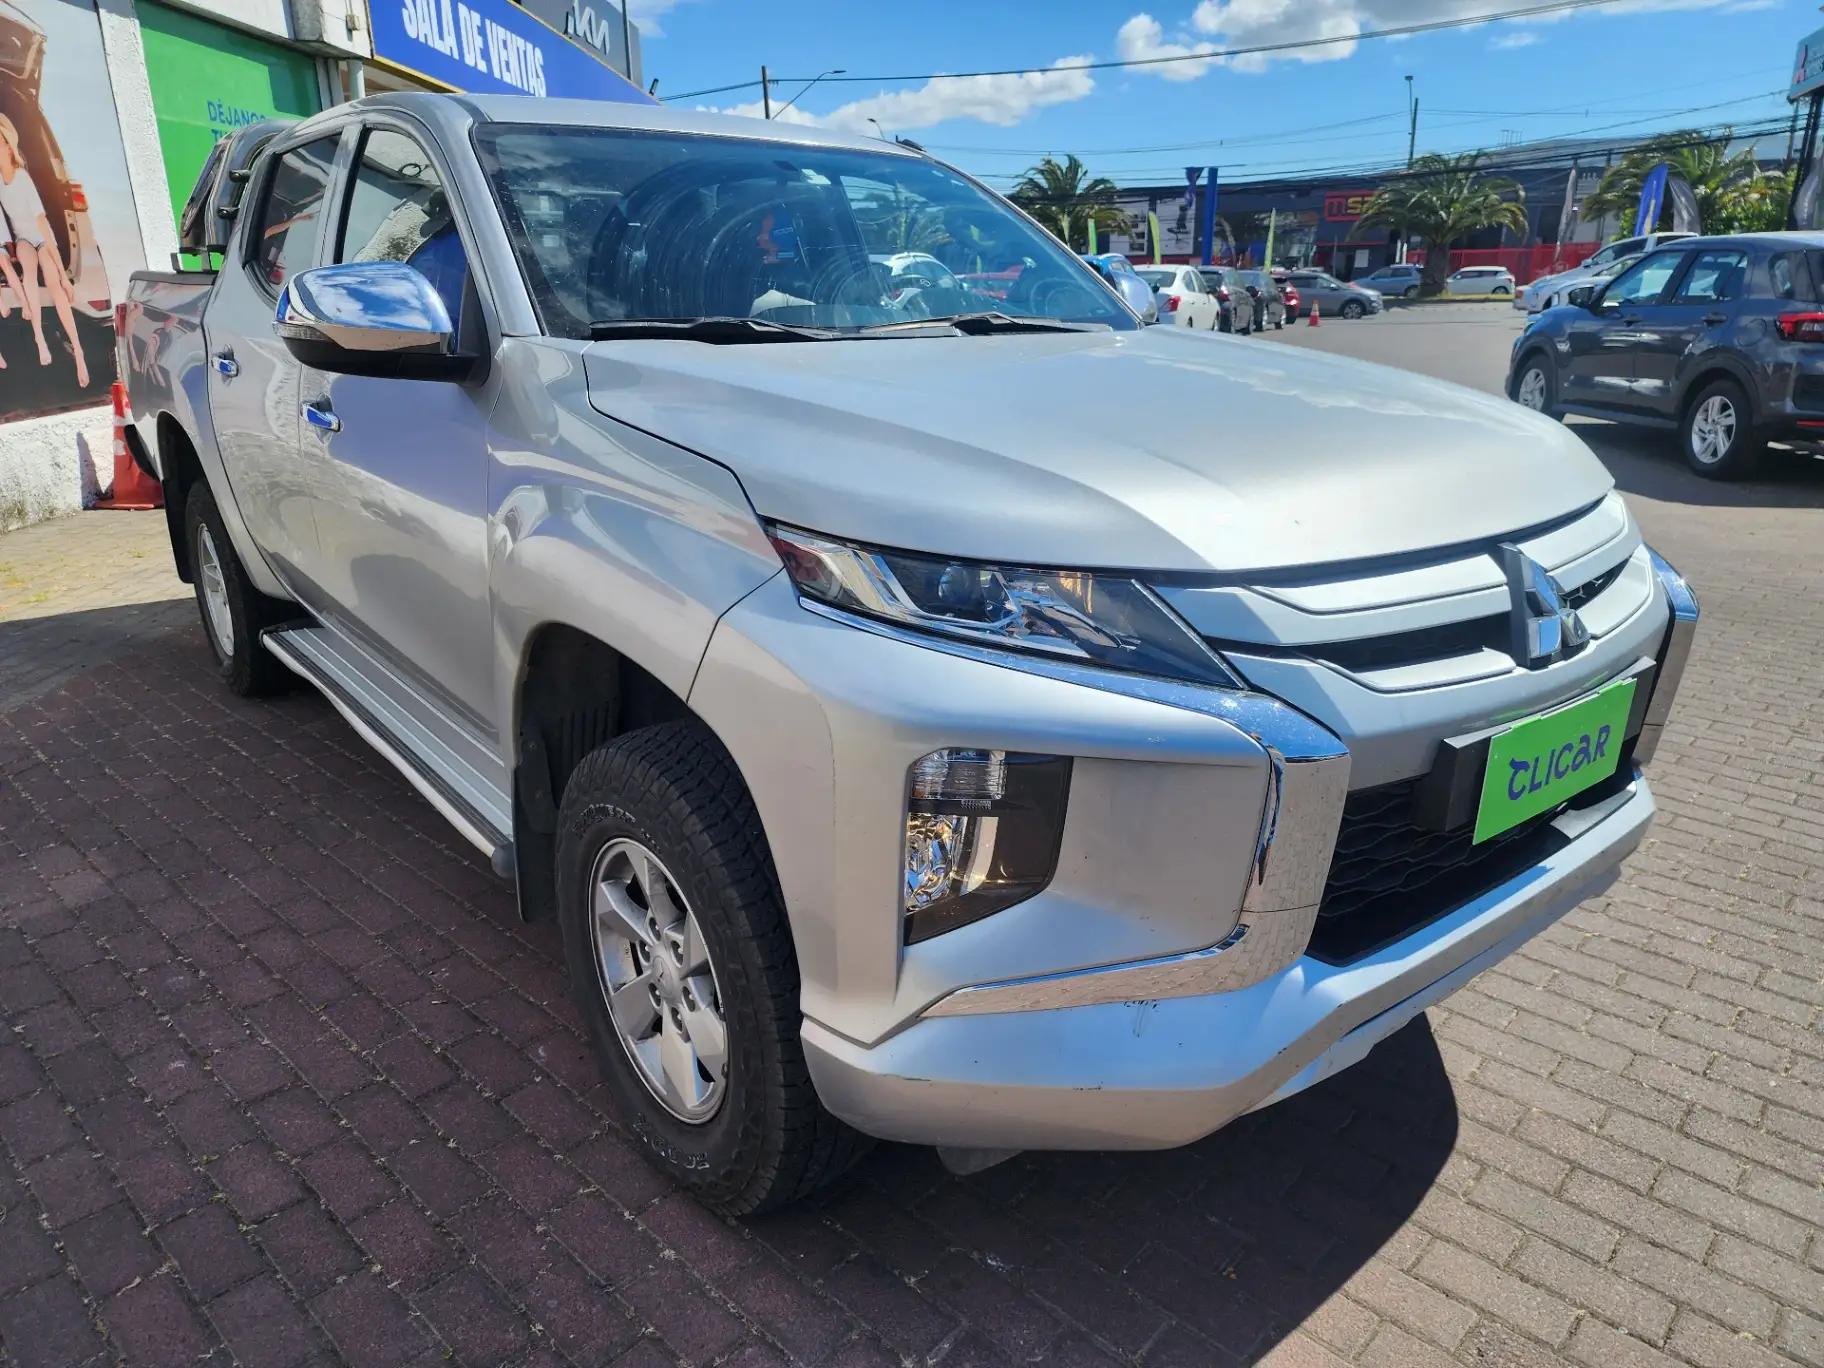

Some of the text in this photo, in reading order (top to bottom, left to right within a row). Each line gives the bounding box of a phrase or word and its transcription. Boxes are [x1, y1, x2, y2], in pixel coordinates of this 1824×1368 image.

[402, 0, 547, 97] SALA DE VENTAS
